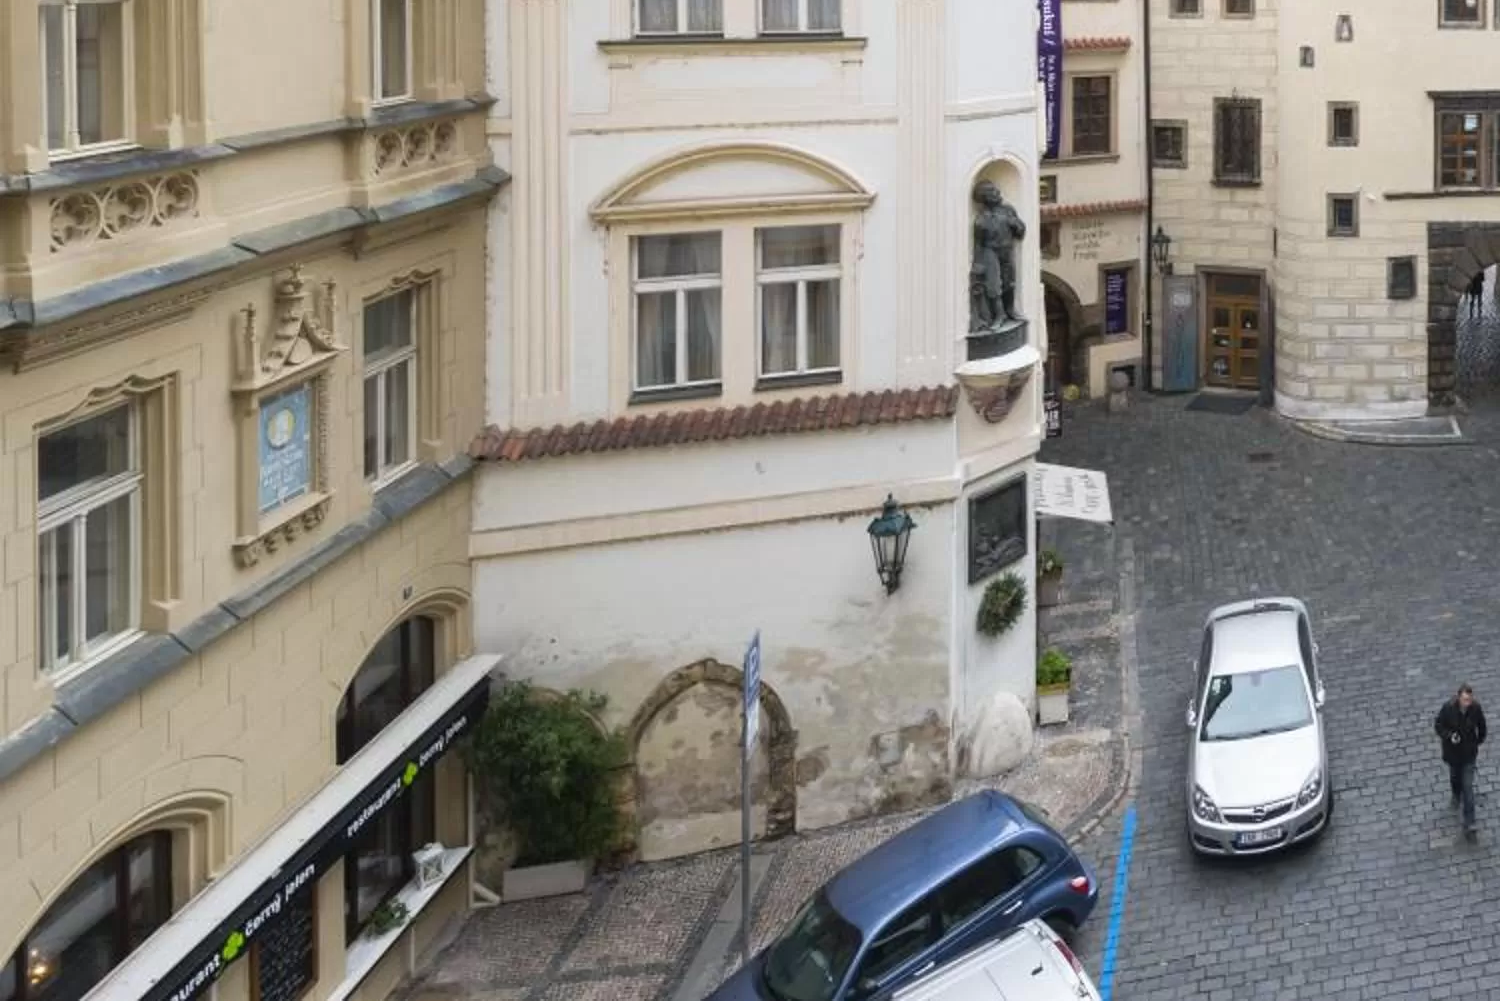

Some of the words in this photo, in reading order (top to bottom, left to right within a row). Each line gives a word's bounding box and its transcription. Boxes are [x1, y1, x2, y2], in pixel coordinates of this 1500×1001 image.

[347, 776, 401, 837] restaurant
[420, 734, 445, 767] černý
[445, 716, 467, 744] jelen
[245, 892, 281, 938] černý
[285, 863, 315, 902] jelen
